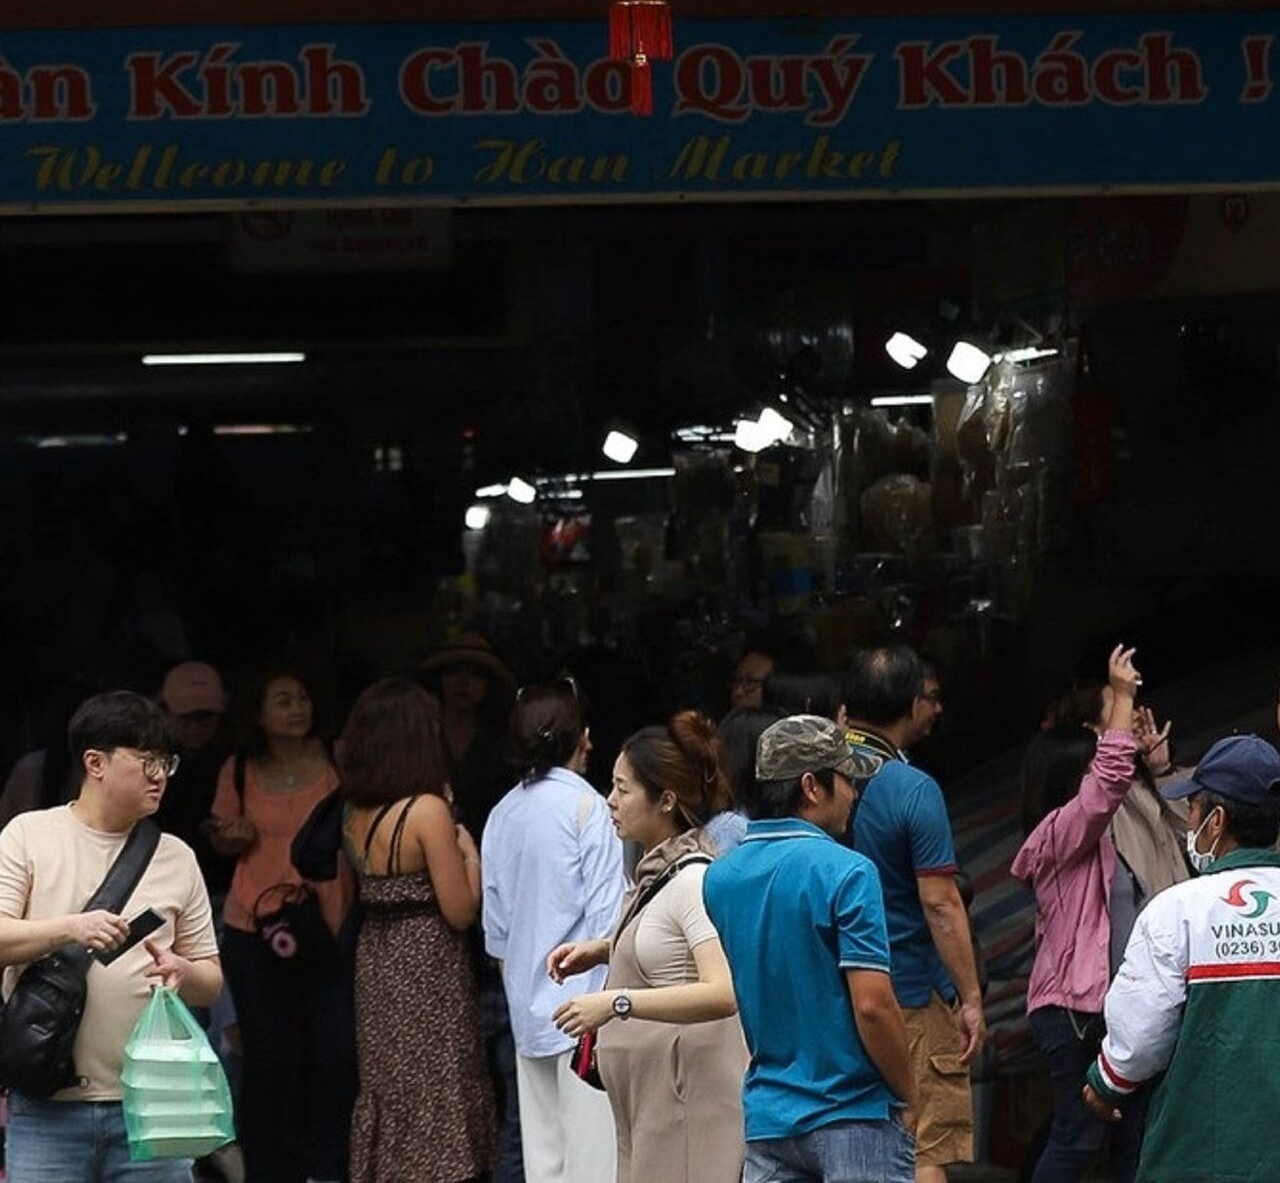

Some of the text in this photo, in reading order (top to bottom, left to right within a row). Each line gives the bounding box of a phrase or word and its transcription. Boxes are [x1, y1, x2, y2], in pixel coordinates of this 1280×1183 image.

[125, 43, 370, 124] Kính
[399, 39, 635, 118] Chào
[672, 32, 870, 127] Quý
[897, 30, 1208, 111] Khách
[1240, 34, 1275, 104] !
[28, 133, 902, 192] Wellcome to Han Market
[1215, 940, 1265, 959] (0236)
